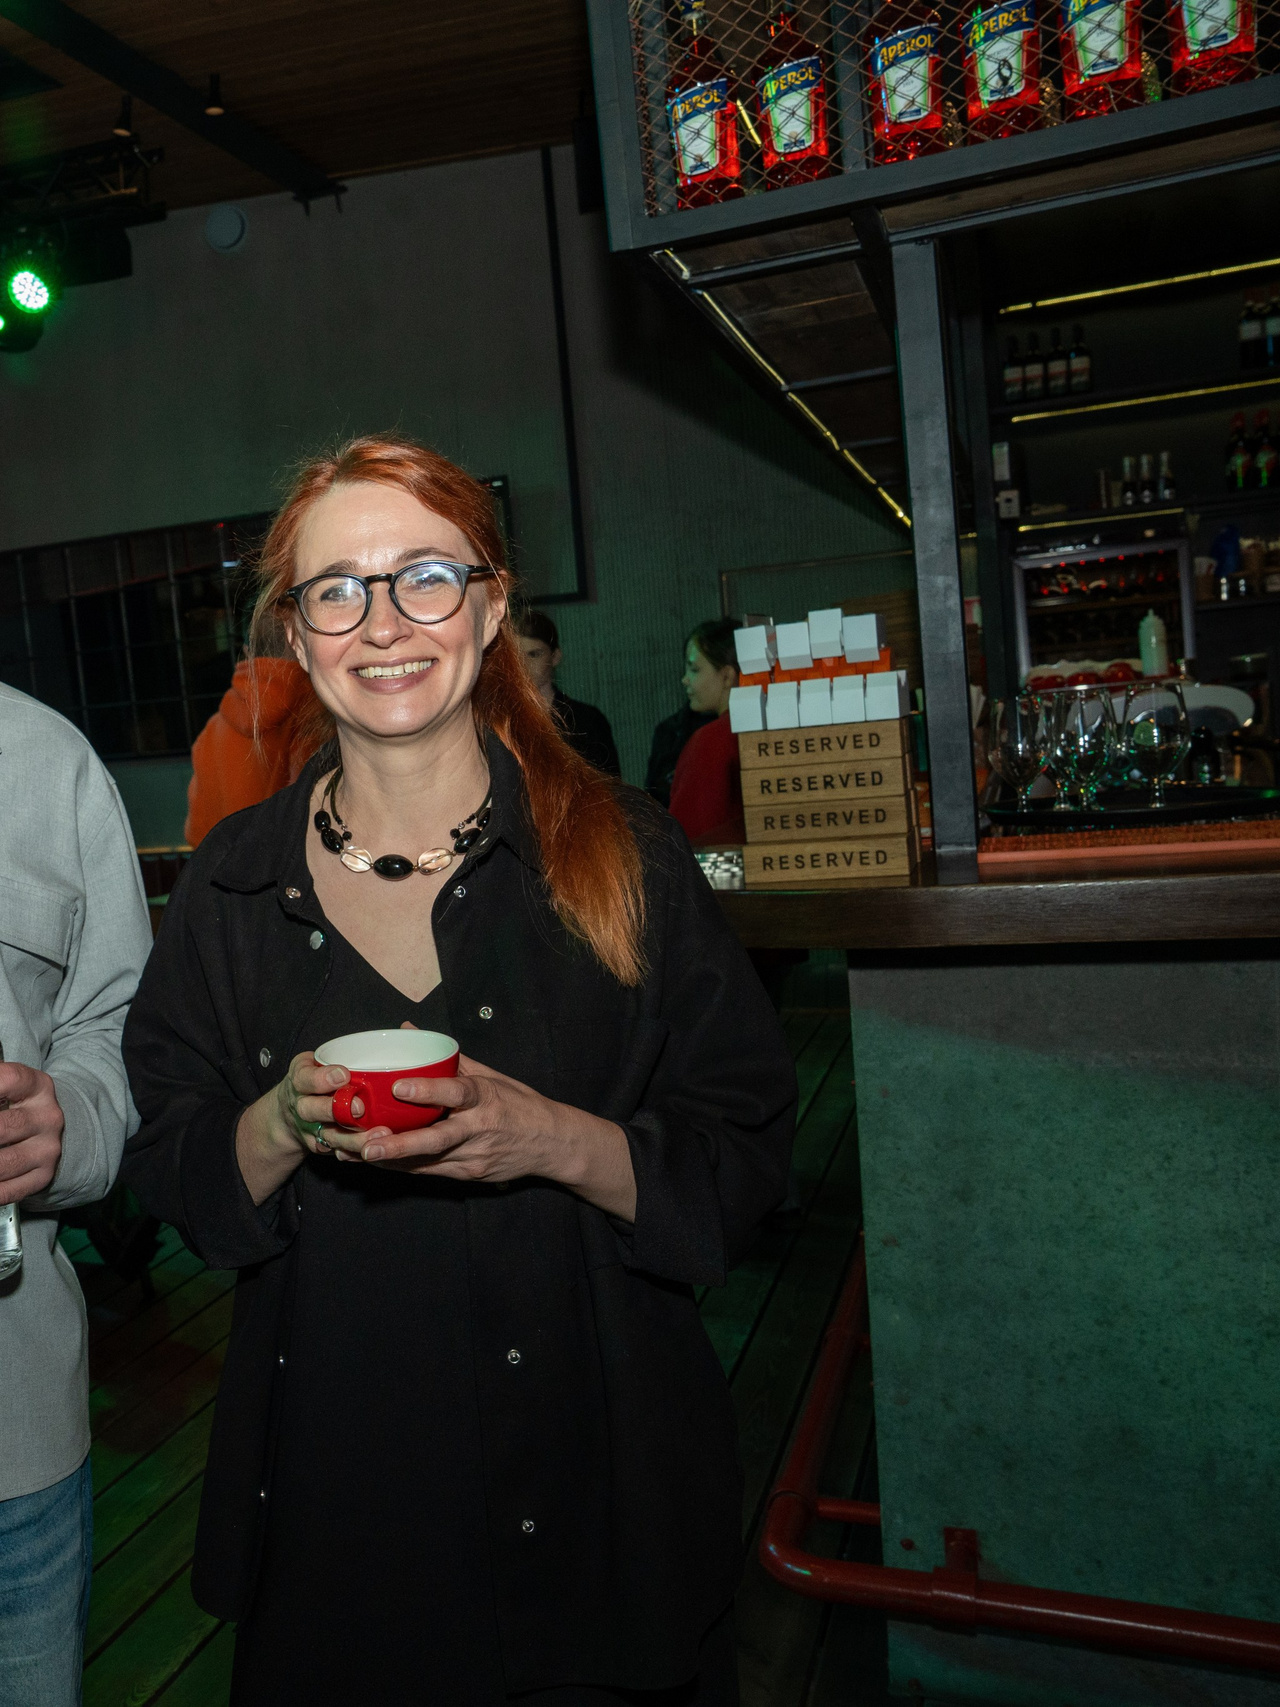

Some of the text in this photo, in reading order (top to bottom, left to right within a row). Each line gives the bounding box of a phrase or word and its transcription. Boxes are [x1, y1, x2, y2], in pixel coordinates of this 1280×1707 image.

[969, 7, 1031, 47] APEROL
[762, 66, 816, 104] APEROL
[757, 732, 881, 757] RESERVED
[760, 770, 883, 795] RESERVED
[763, 808, 887, 830] RESERVED
[762, 849, 888, 871] RESERVED
